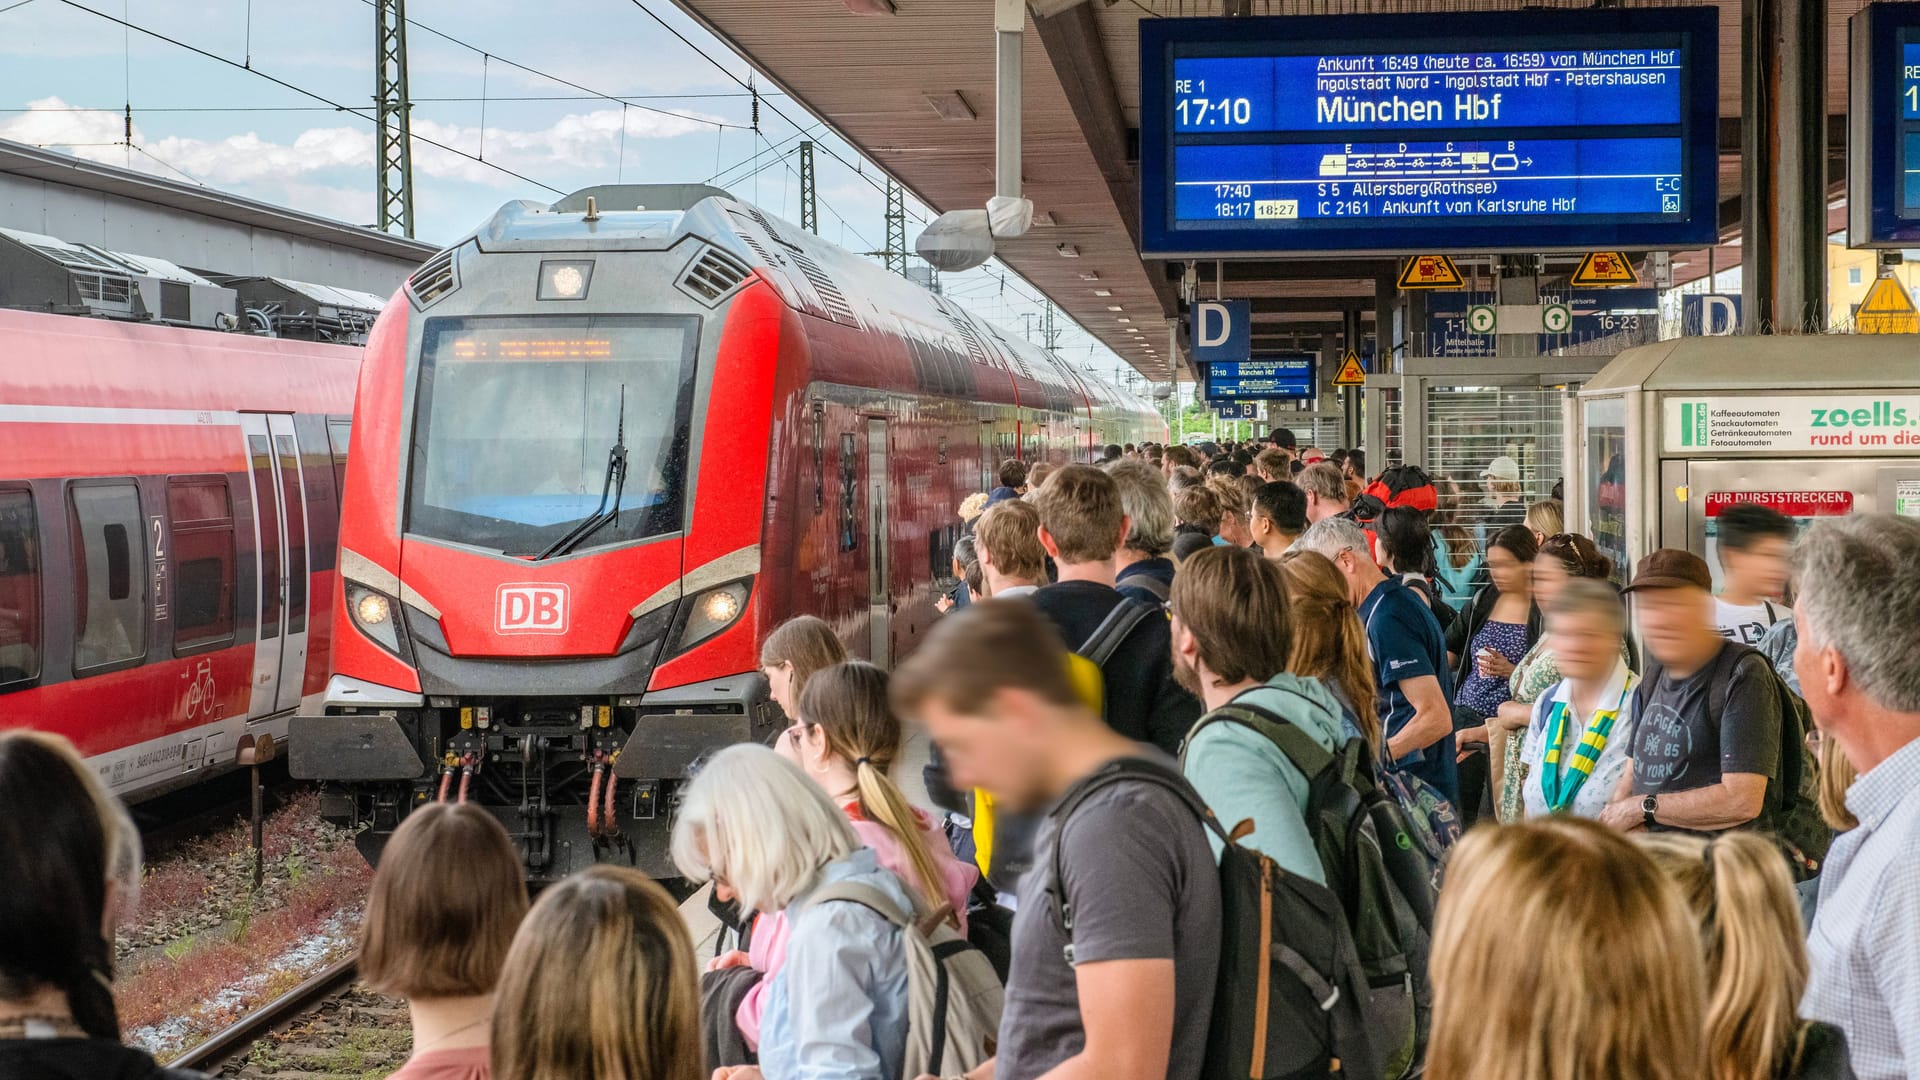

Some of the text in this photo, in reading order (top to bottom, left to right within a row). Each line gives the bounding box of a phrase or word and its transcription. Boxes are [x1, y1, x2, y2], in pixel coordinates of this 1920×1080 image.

[1317, 51, 1675, 71] Ankunft 16:49 (heute ca. 16:59) von München Hbf
[1905, 66, 1920, 79] RE
[1175, 80, 1205, 94] RE 1
[1317, 76, 1391, 93] Ingolstadt
[1396, 76, 1429, 89] Nord
[1446, 74, 1520, 91] Ingolstadt
[1524, 73, 1549, 87] Hbf
[1566, 71, 1666, 86] Petershausen
[1176, 93, 1502, 125] 17:10 München Hbf
[1345, 141, 1515, 154] E D C B
[1214, 177, 1681, 198] 17:40 S 5 Allersberg(Rothsee) E-C
[1214, 197, 1577, 217] 18:17 18:27 IC 2161 Ankunft von Karlsruhe Hbf
[1598, 316, 1640, 330] 16-23
[1703, 295, 1737, 337] D
[1198, 303, 1231, 347] D
[1445, 318, 1468, 332] 1-1
[1446, 338, 1485, 346] Mittelhalle
[1211, 369, 1275, 377] 17:10 München Hbf
[1223, 404, 1253, 416] 14 B
[1710, 409, 1781, 418] Kaffeeautomaten
[1810, 400, 1920, 427] zoells.
[1697, 403, 1706, 446] zoells.de
[1710, 419, 1779, 428] Snackautomaten
[1710, 429, 1792, 438] Getränkeautomaten
[1810, 430, 1920, 446] rund um die
[1710, 439, 1772, 448] Fotoautomaten
[1736, 492, 1848, 504] DURSTSTRECKEN.
[154, 519, 164, 557] 2
[504, 591, 560, 626] DB
[1647, 761, 1673, 779] YORK
